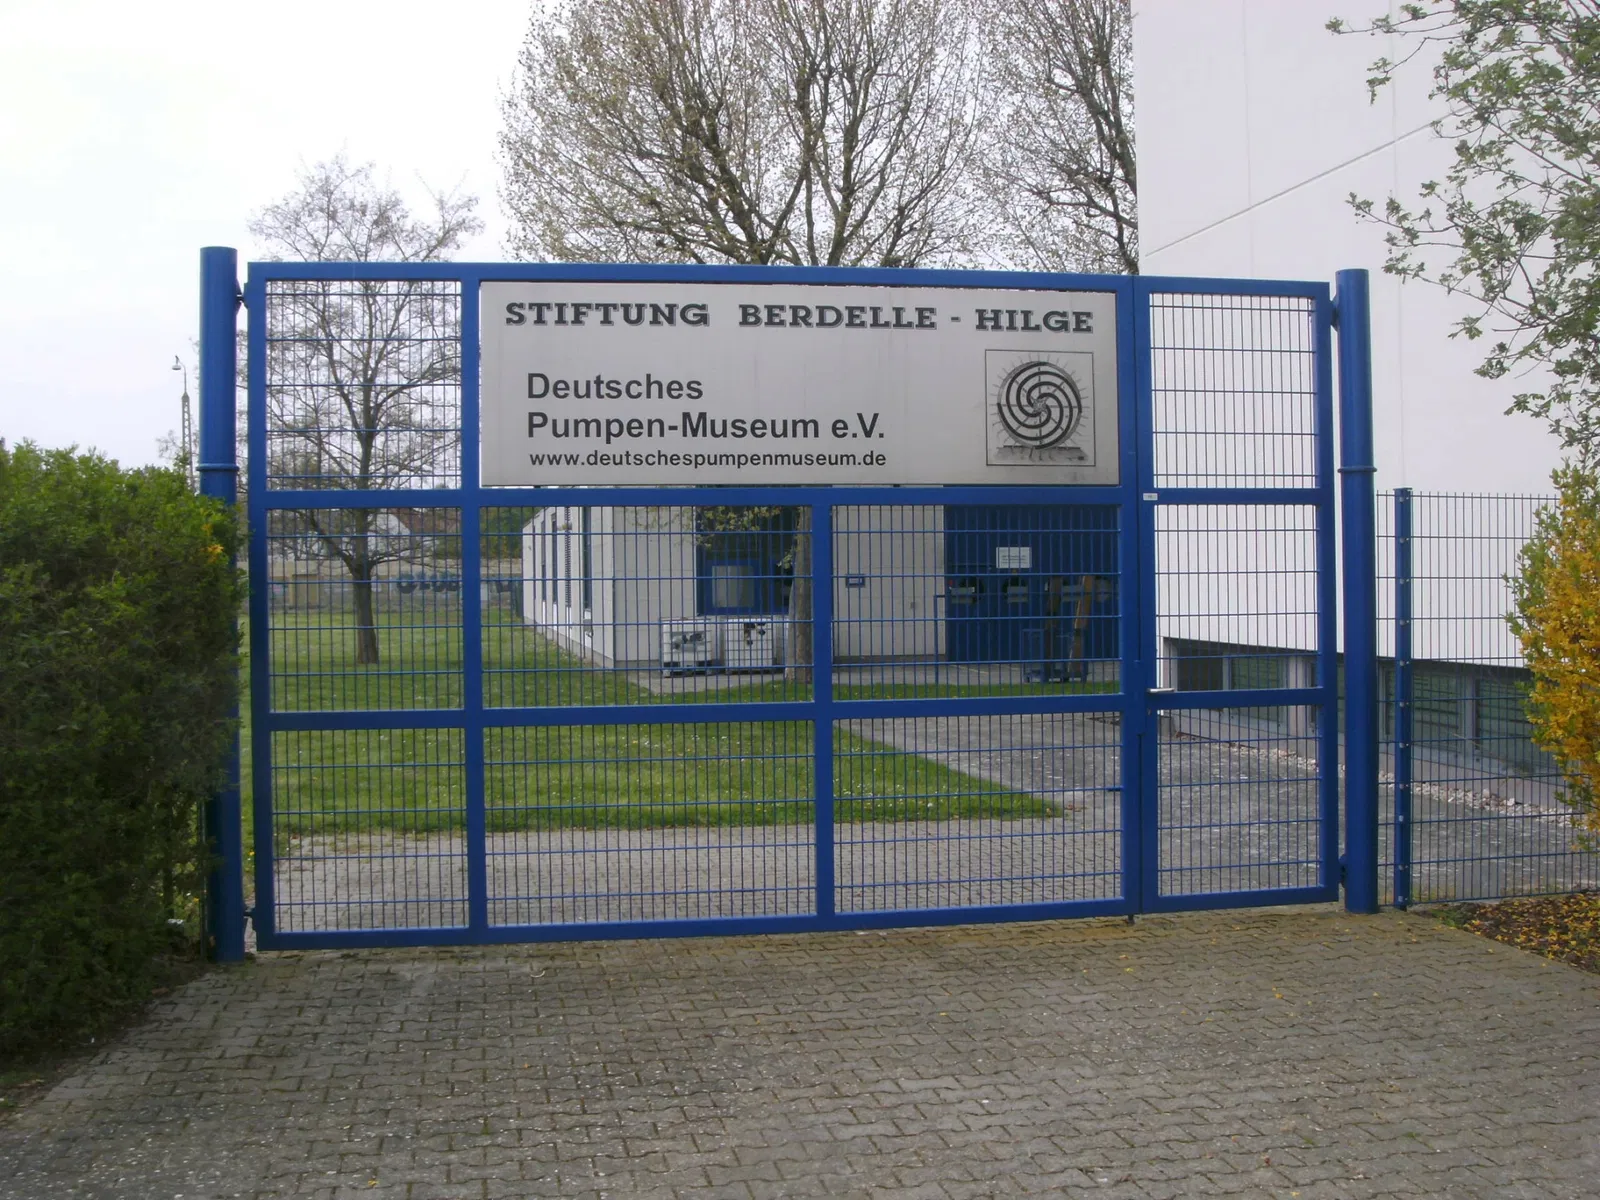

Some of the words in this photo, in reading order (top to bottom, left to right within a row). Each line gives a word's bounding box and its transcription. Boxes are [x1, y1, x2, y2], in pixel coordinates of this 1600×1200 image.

[505, 302, 709, 327] STIFTUNG
[738, 304, 937, 330] BERDELLE
[975, 308, 1095, 334] HILGE
[527, 372, 704, 400] Deutsches
[528, 411, 820, 445] Pumpen-Museum
[831, 412, 885, 439] e.V.
[529, 449, 887, 470] www.deutschespumpenmuseum.de
